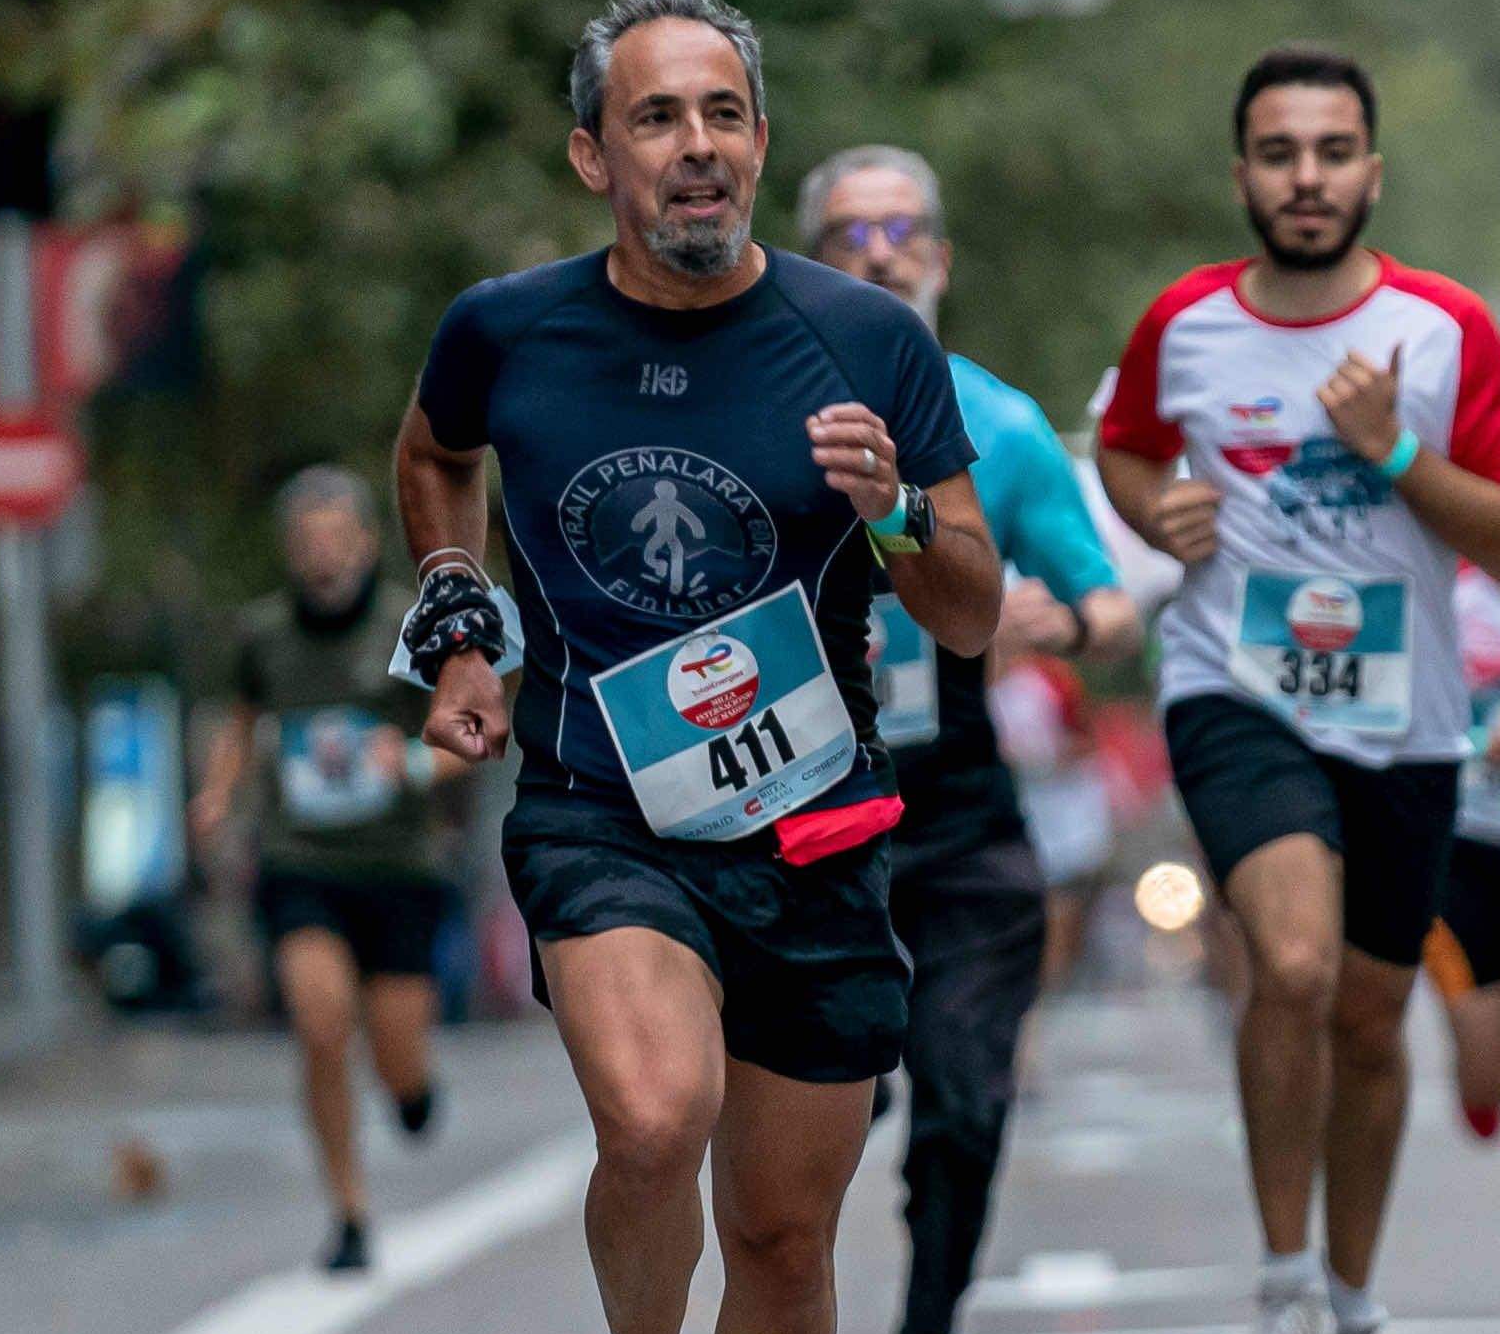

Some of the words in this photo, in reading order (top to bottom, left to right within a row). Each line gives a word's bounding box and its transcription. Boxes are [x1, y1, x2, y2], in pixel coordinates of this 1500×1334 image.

[565, 483, 601, 548] TRAIL
[606, 578, 746, 617] Finisher
[1279, 648, 1360, 697] 334
[707, 706, 796, 793] 411
